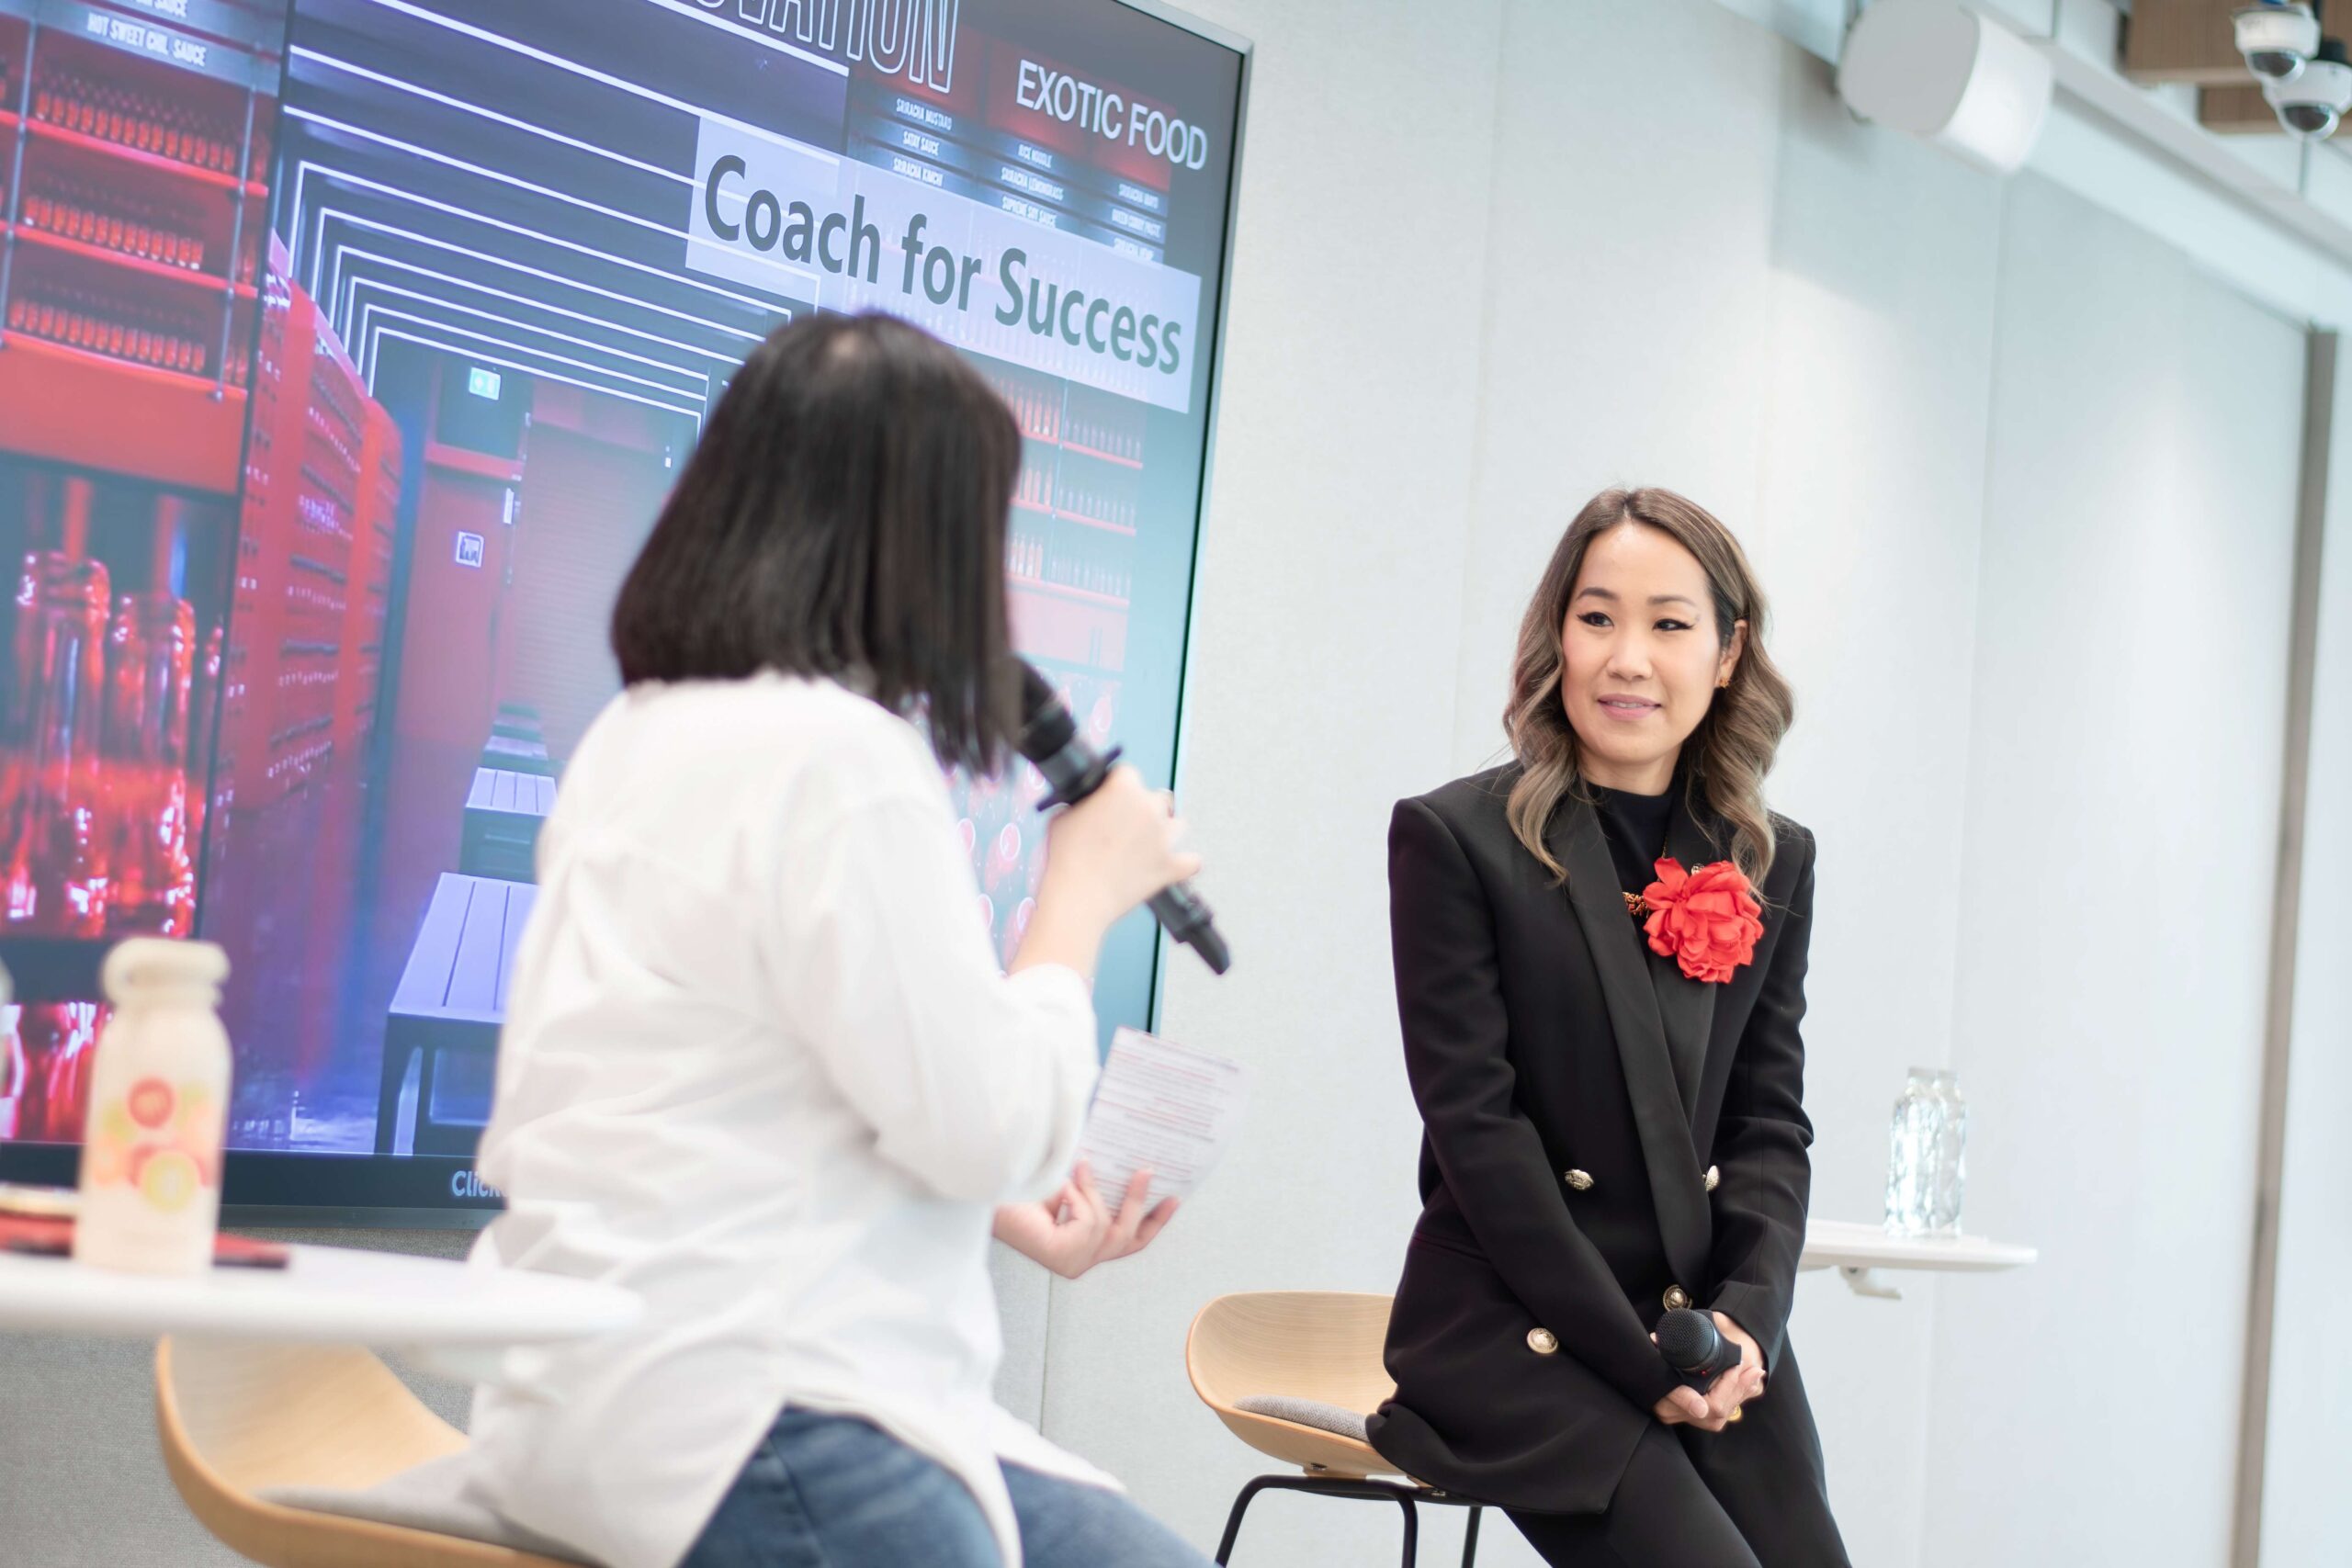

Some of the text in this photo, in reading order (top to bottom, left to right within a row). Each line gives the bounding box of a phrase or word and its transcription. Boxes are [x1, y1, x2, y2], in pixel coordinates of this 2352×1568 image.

[108, 18, 146, 47] SWEET
[172, 39, 207, 67] SAUCE
[1016, 59, 1208, 171] EXOTIC FOOD
[705, 154, 1182, 375] Coach for Success
